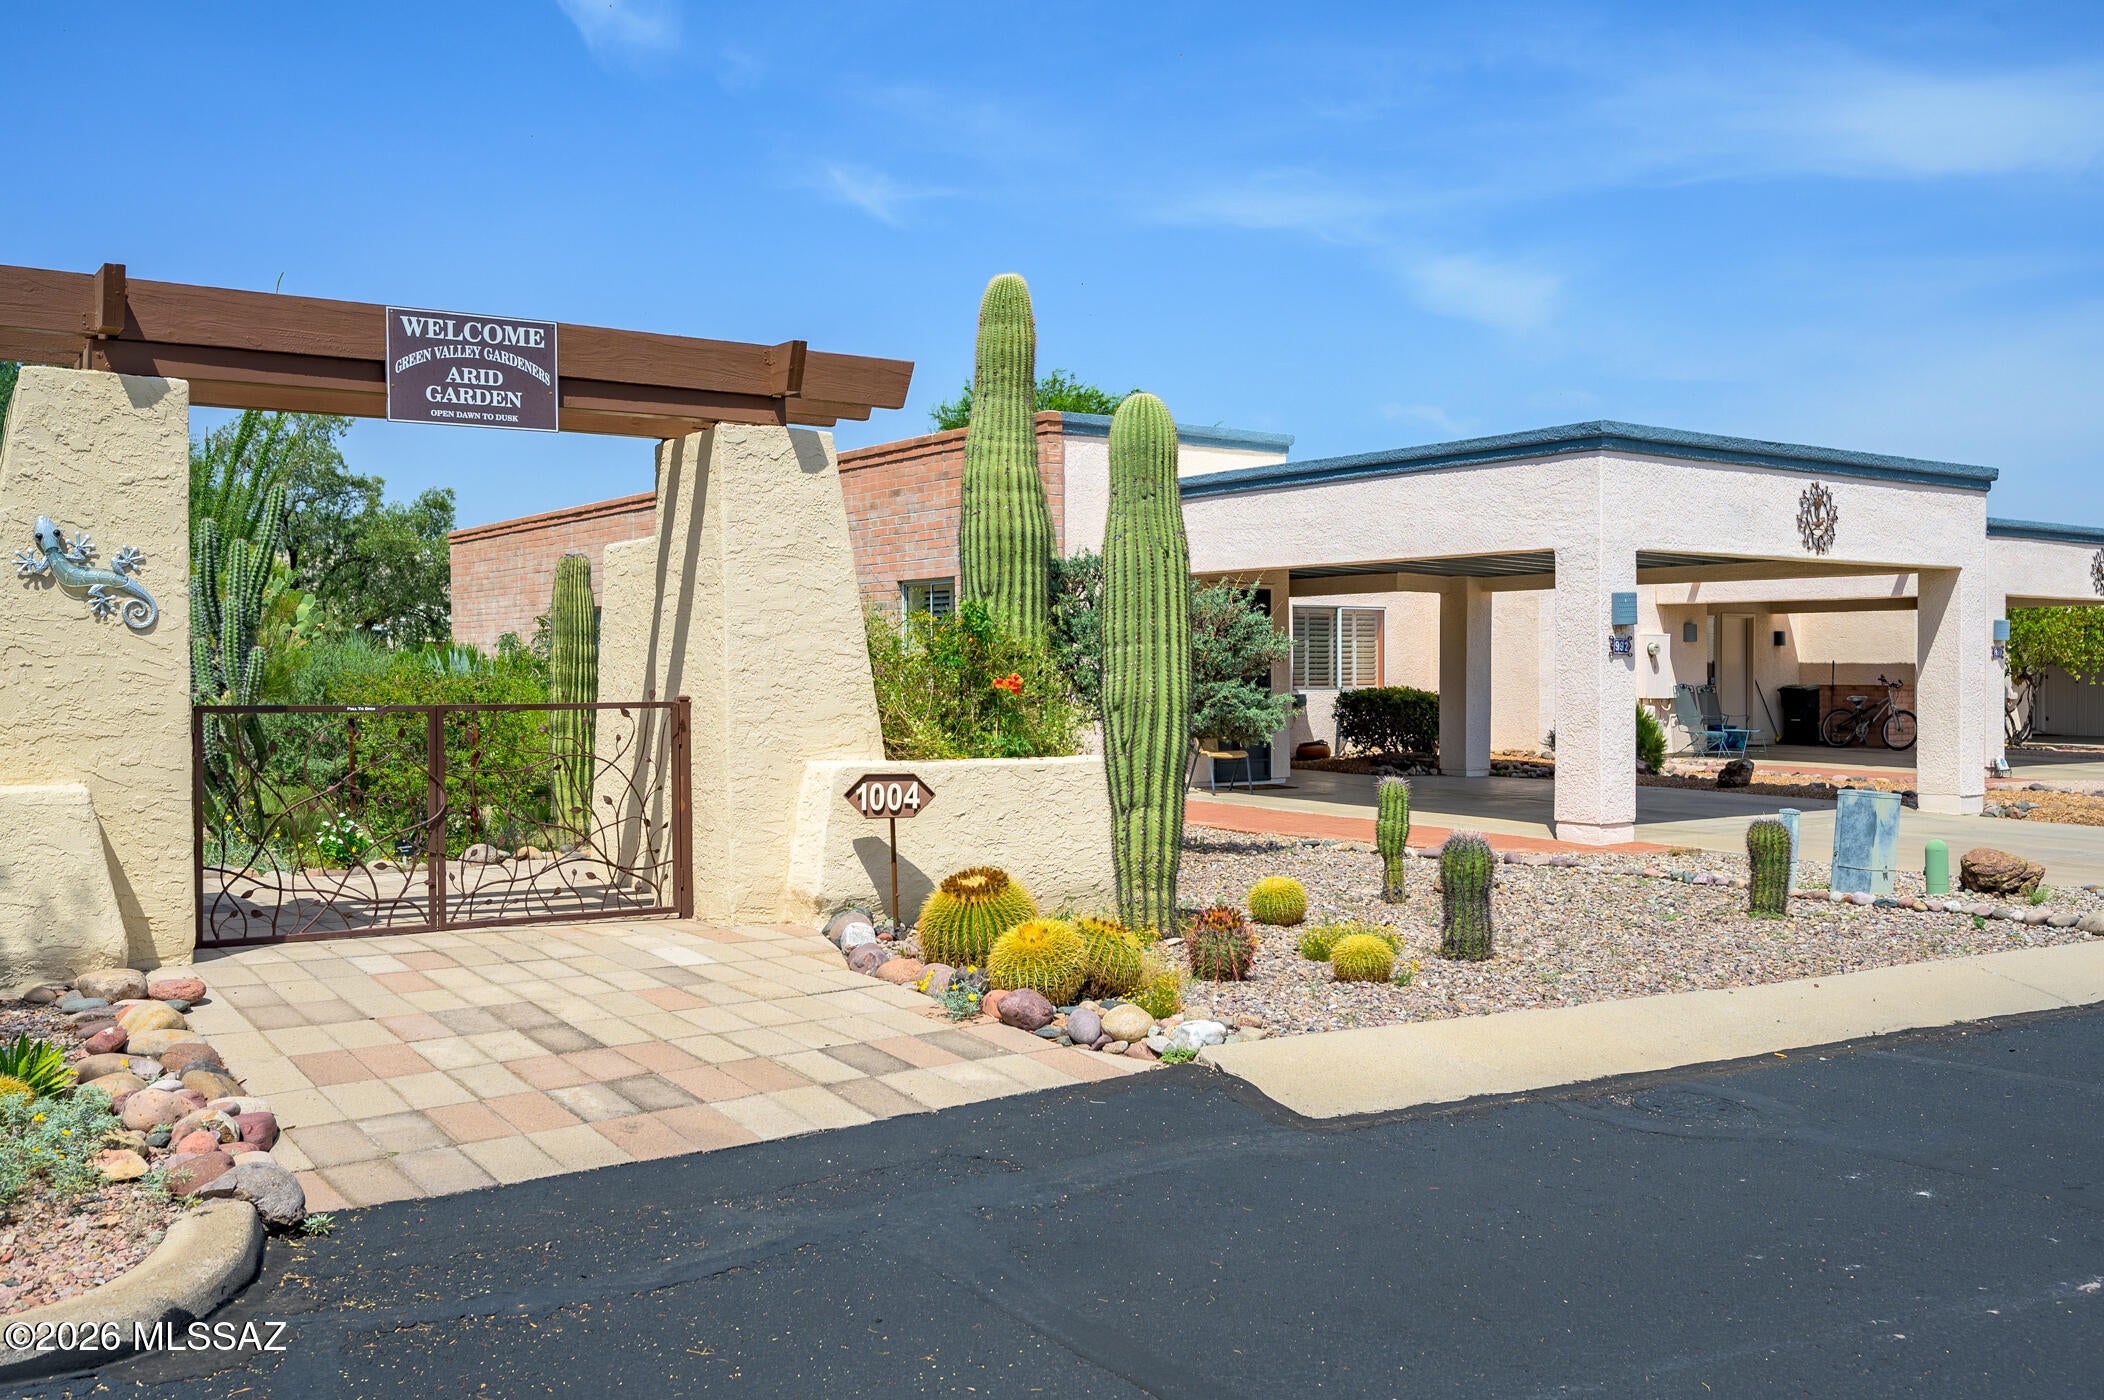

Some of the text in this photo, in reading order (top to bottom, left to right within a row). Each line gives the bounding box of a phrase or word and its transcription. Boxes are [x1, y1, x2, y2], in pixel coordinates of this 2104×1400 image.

[400, 315, 545, 349] WELCOME
[395, 345, 551, 387] GREEN VALLEY GARDENERS
[445, 366, 504, 387] ARID
[425, 385, 523, 409] GARDEN
[430, 409, 519, 423] OPEN DAWN TO DUSK
[1615, 641, 1629, 652] 992
[855, 781, 921, 811] 1004
